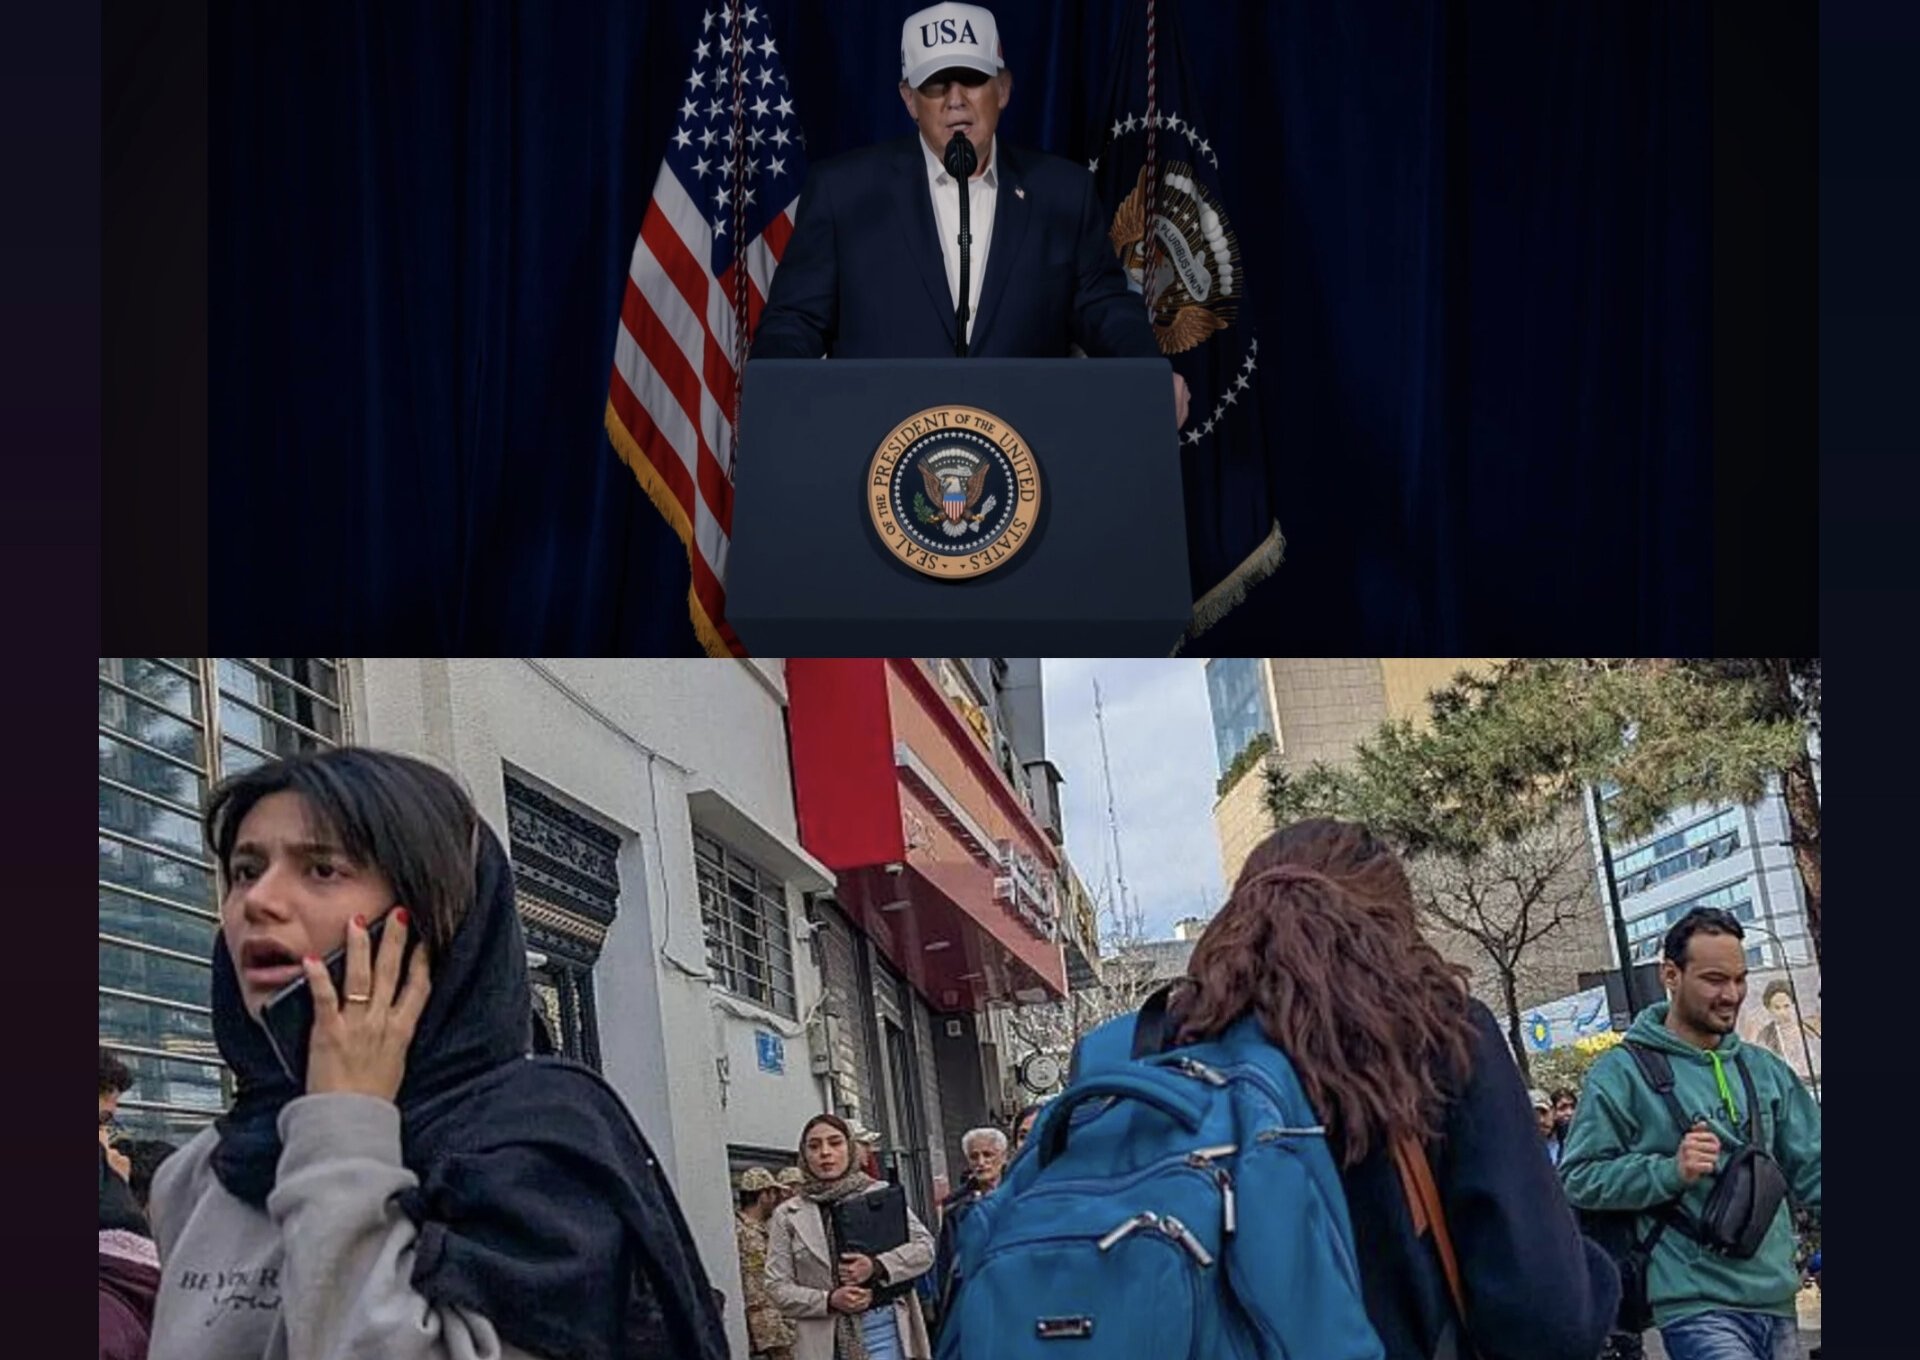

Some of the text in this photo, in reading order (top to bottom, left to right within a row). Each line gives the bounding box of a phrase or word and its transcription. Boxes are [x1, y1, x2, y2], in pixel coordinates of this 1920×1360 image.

[920, 18, 979, 48] USA
[1161, 223, 1190, 270] PLURIBUS
[1185, 266, 1204, 295] UNUM
[874, 412, 1035, 570] SEAL OF THE PRESIDENT OF THE UNITED STATES
